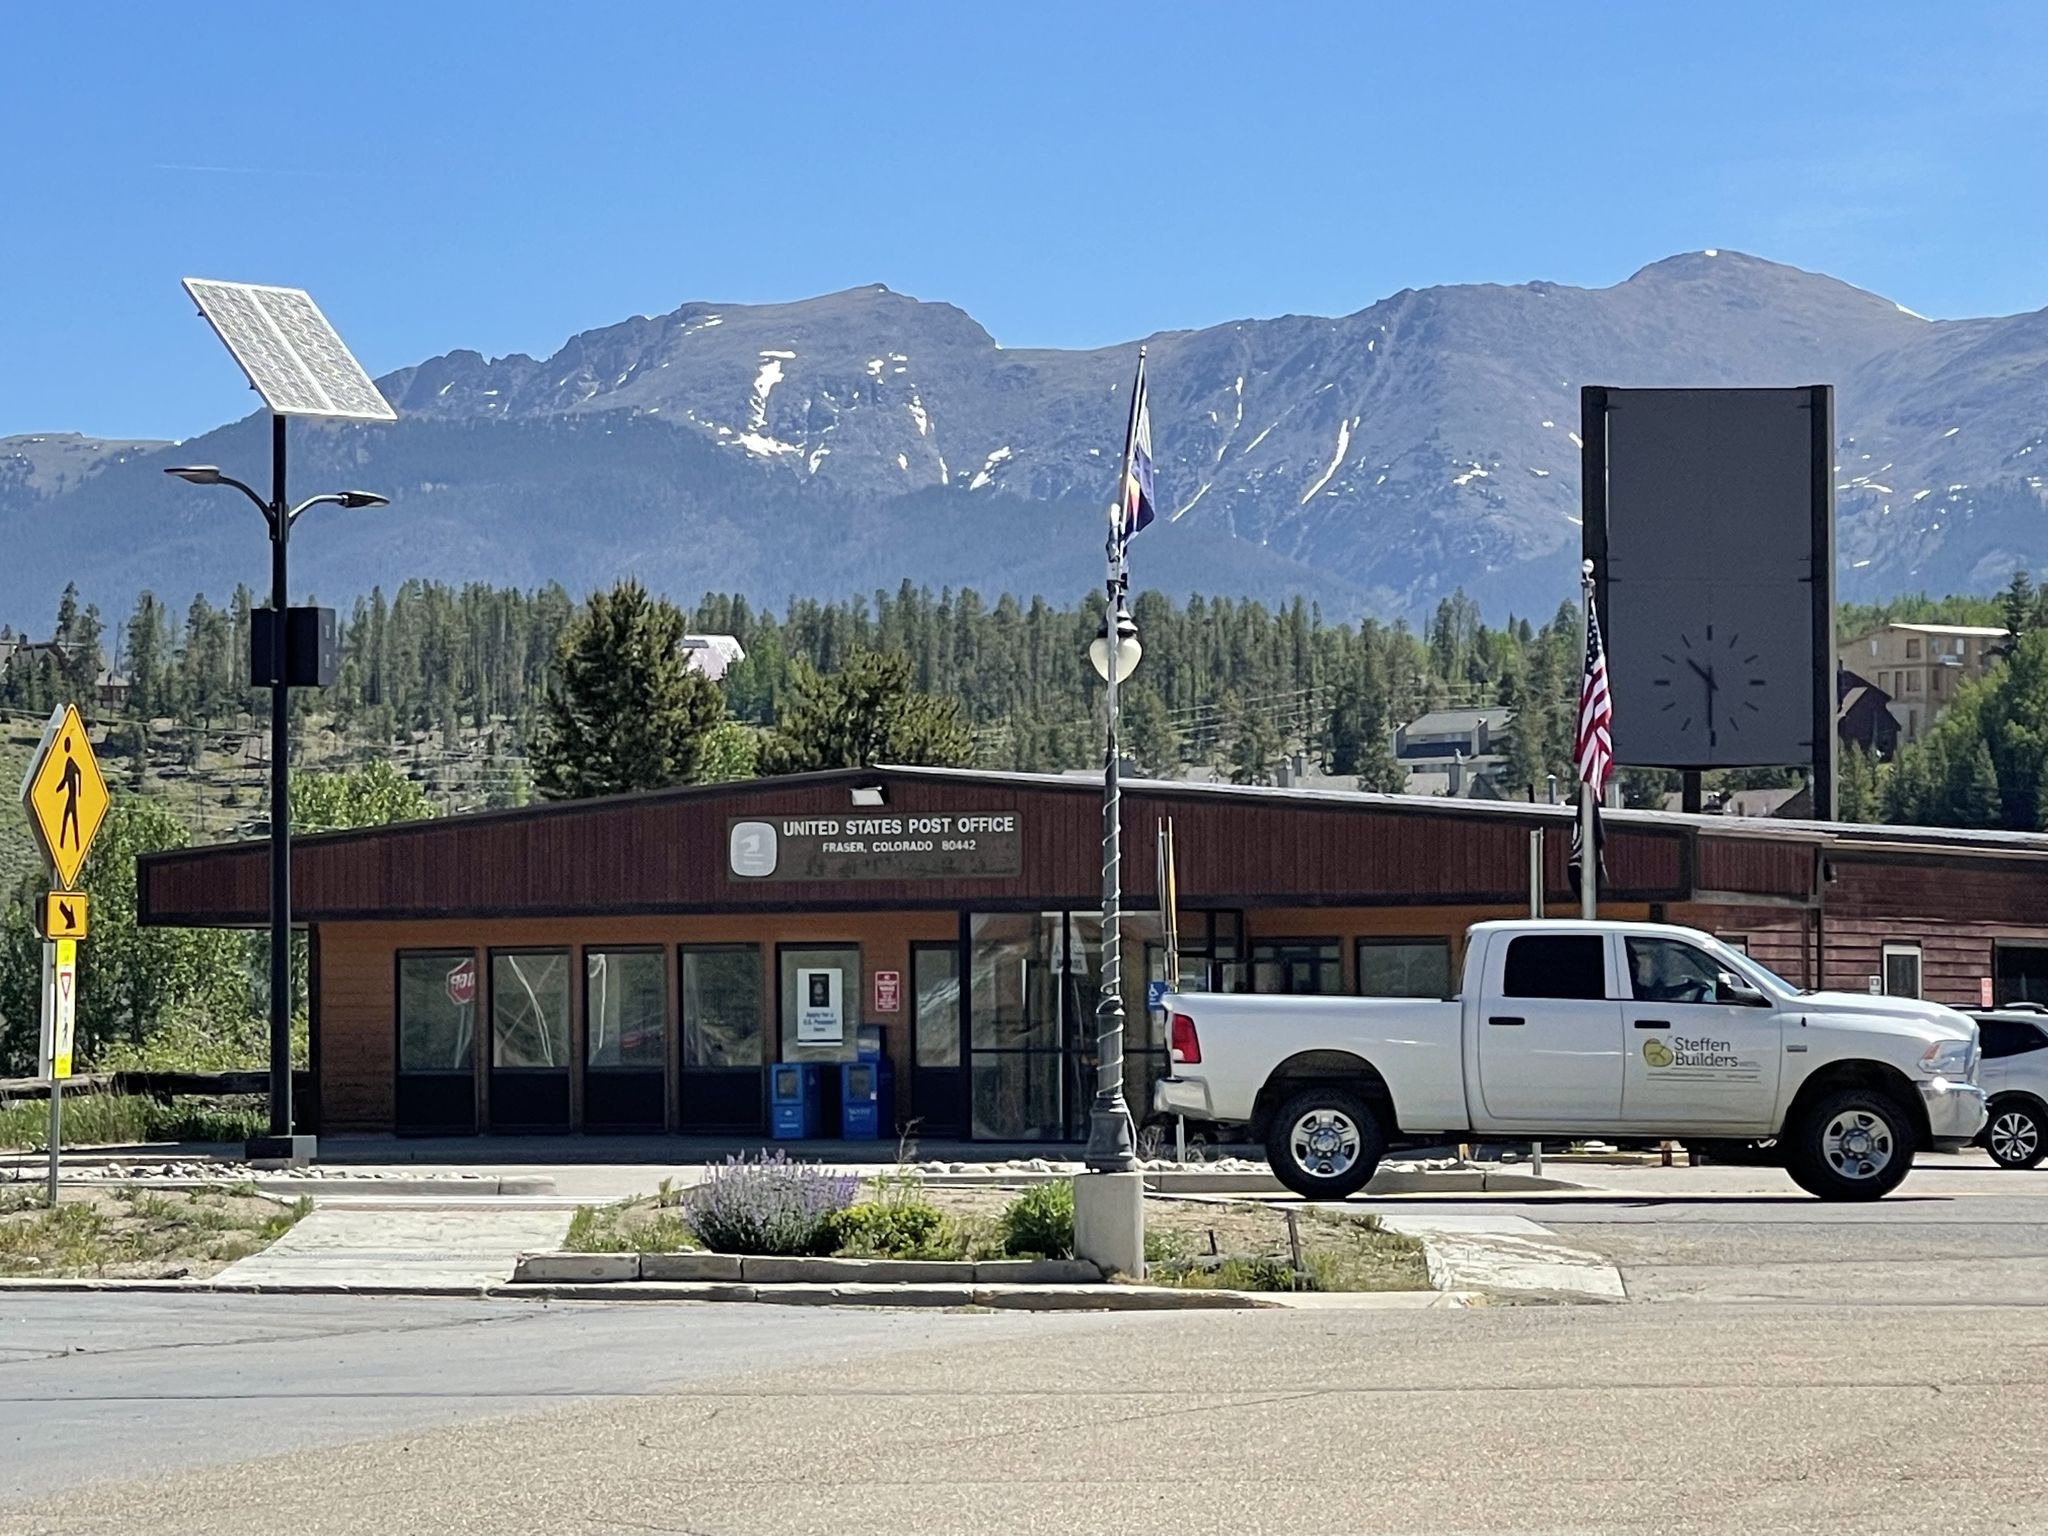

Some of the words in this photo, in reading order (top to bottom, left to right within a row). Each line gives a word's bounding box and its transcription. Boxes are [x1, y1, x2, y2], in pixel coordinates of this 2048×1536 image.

[783, 820, 839, 837] UNITED
[846, 819, 902, 835] STATES
[908, 818, 951, 834] POST
[957, 817, 1014, 833] OFFICE
[822, 842, 867, 854] FRASER,
[872, 841, 933, 853] COLORADO
[941, 840, 976, 851] 80442
[1674, 1036, 1731, 1052] Steffen
[1675, 1051, 1739, 1068] Builders
